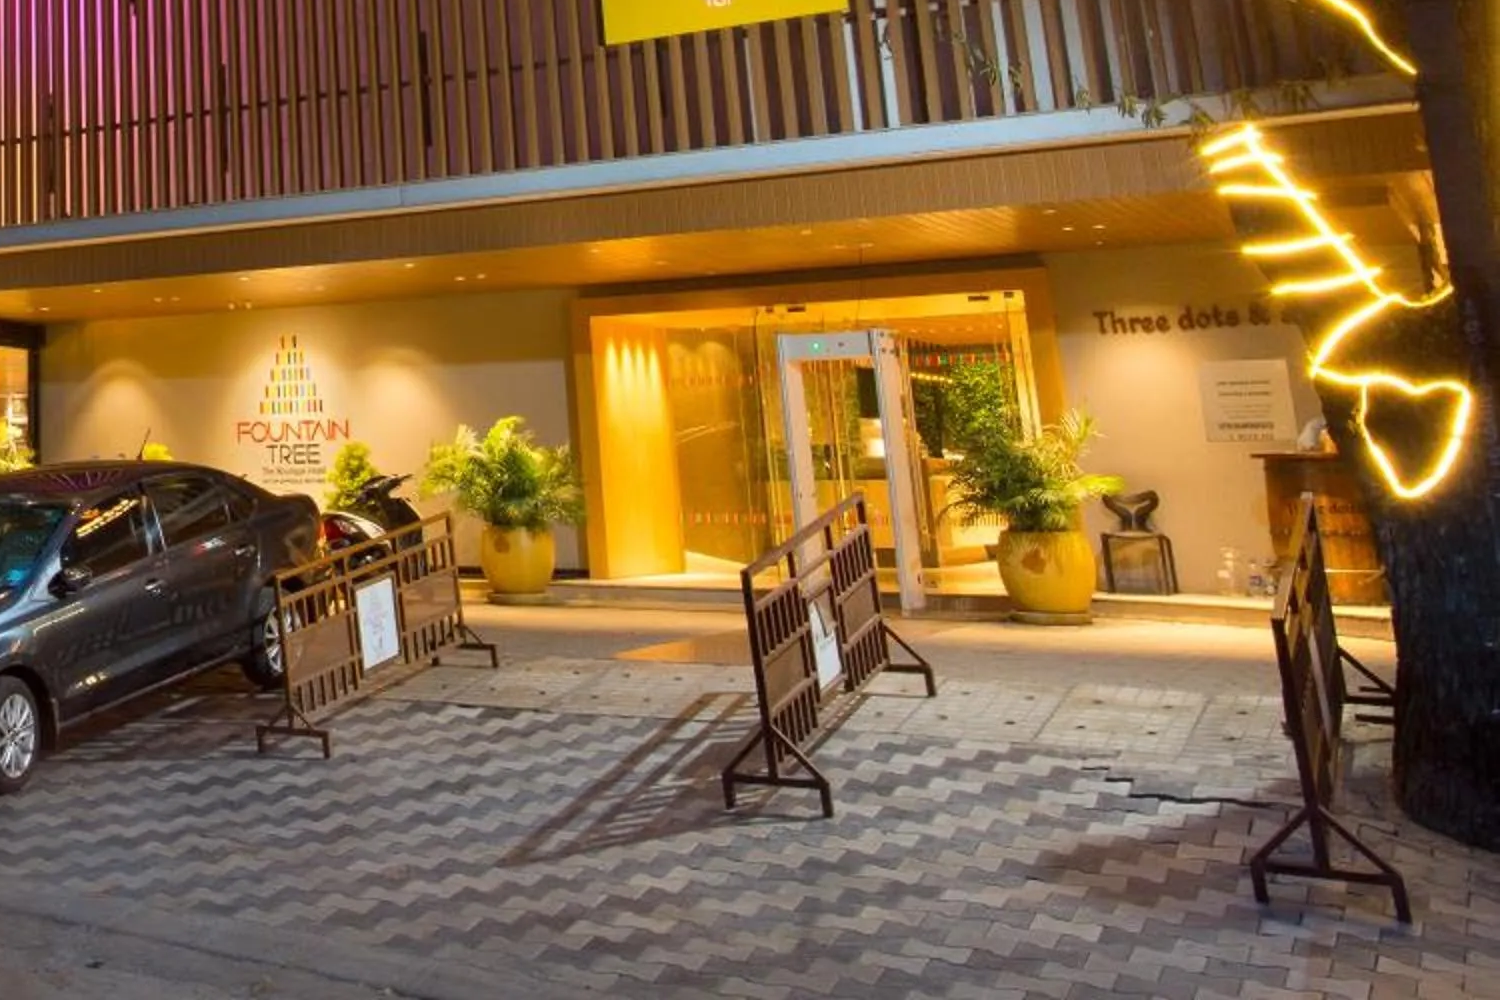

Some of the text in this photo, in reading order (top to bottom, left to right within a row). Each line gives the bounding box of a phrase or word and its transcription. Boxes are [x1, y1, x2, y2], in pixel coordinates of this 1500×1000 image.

[1092, 310, 1171, 335] Three
[1177, 304, 1240, 330] dots
[236, 419, 350, 444] FOUNTAIN
[266, 443, 321, 465] TREE
